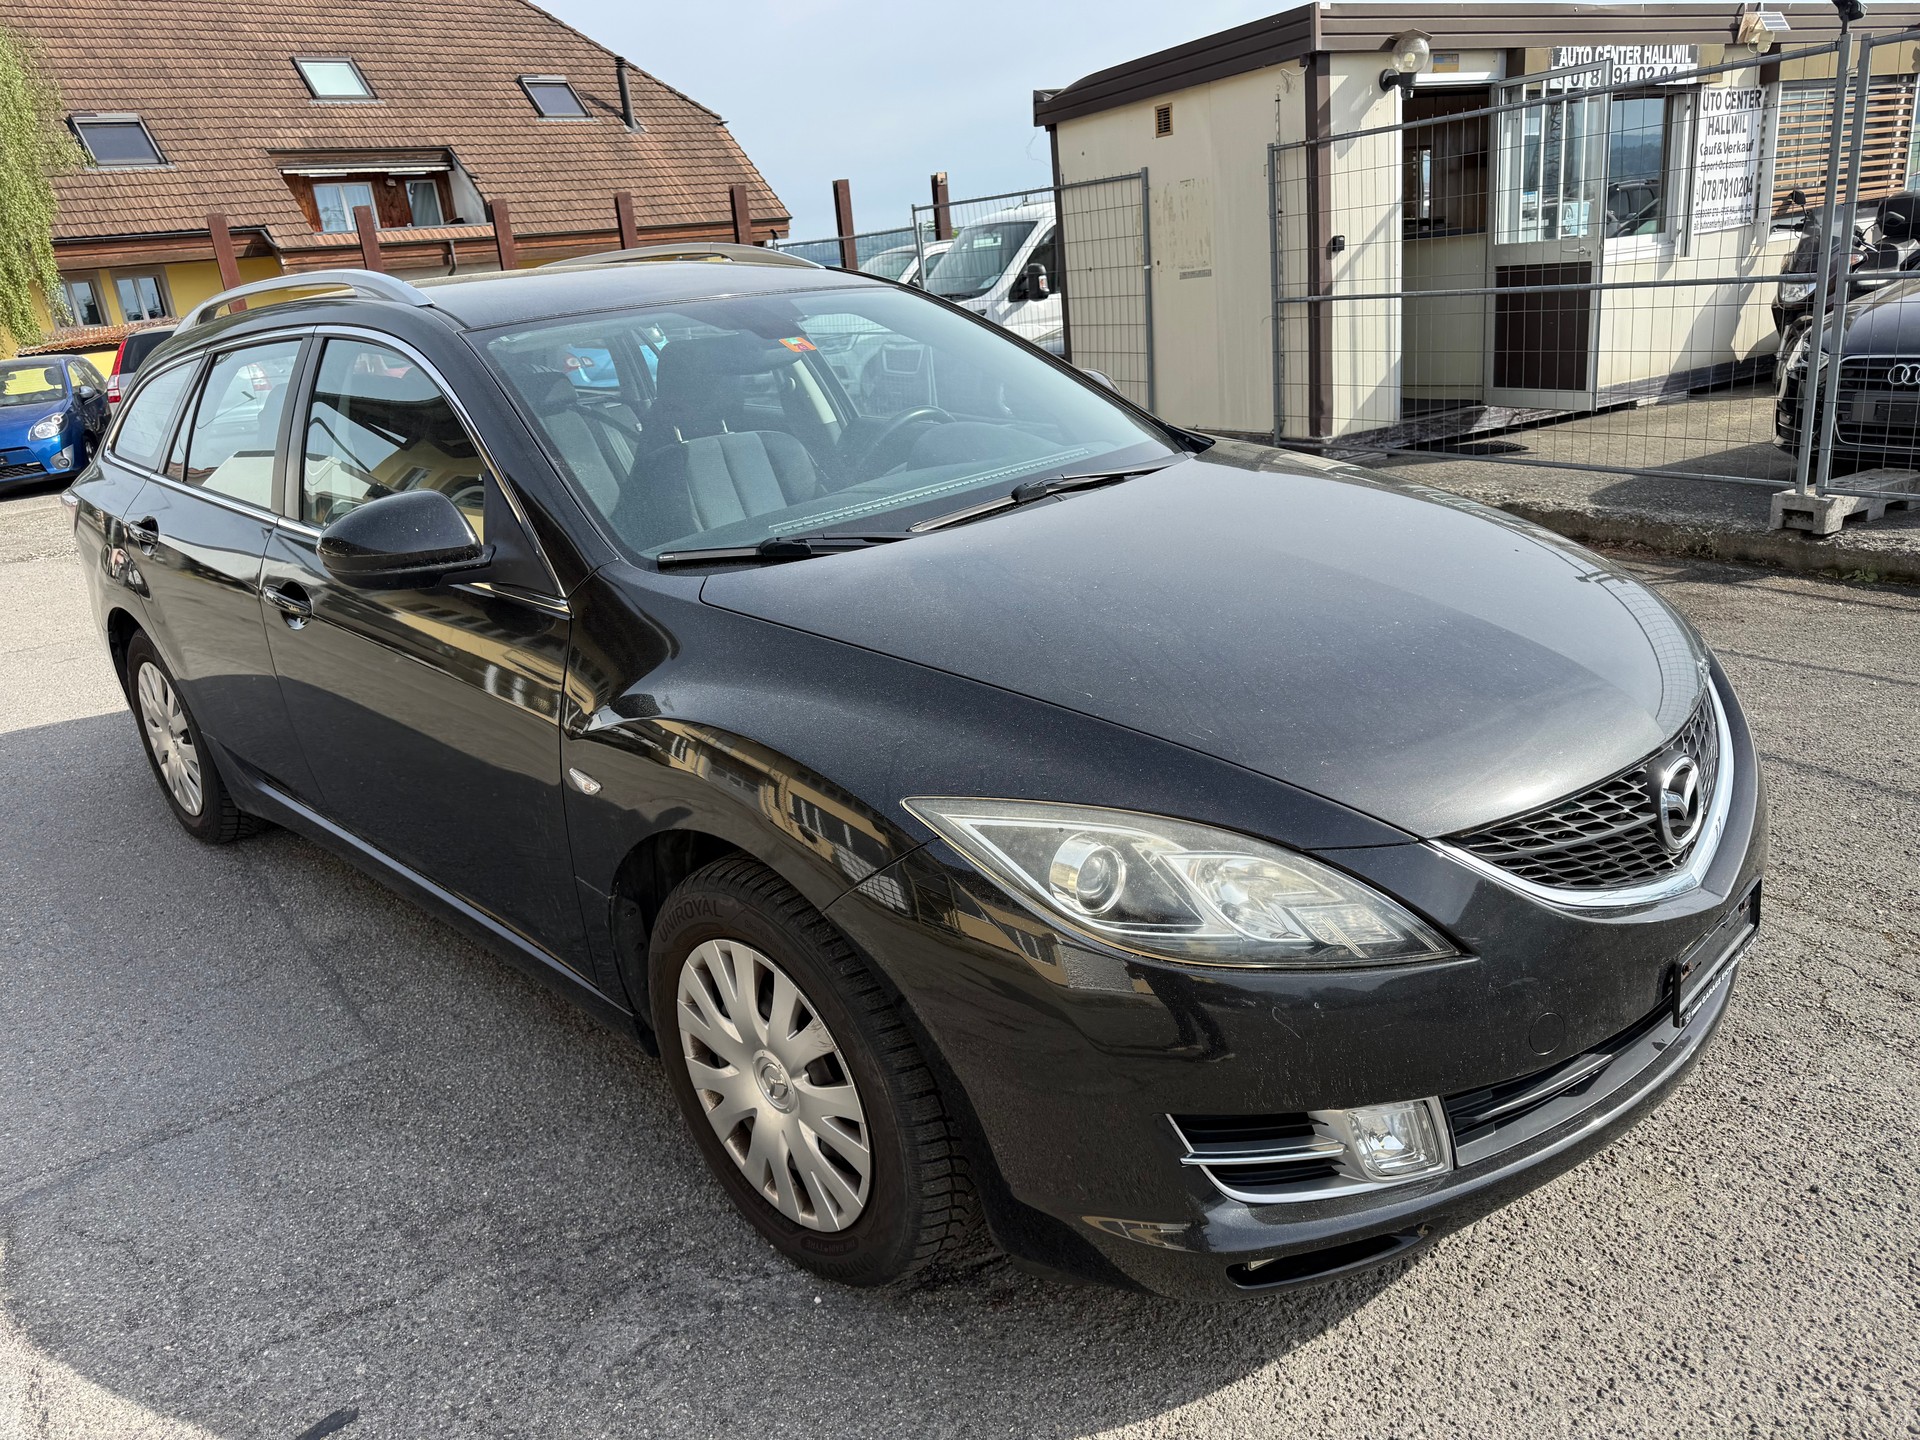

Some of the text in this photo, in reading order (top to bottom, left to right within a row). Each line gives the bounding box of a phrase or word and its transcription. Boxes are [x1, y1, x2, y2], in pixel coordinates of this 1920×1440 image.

[1559, 45, 1691, 66] AUTO CENTER HALLWIL
[1725, 90, 1762, 110] CENTER
[1707, 115, 1747, 136] HALLWIL
[658, 899, 723, 943] UNIROYAL
